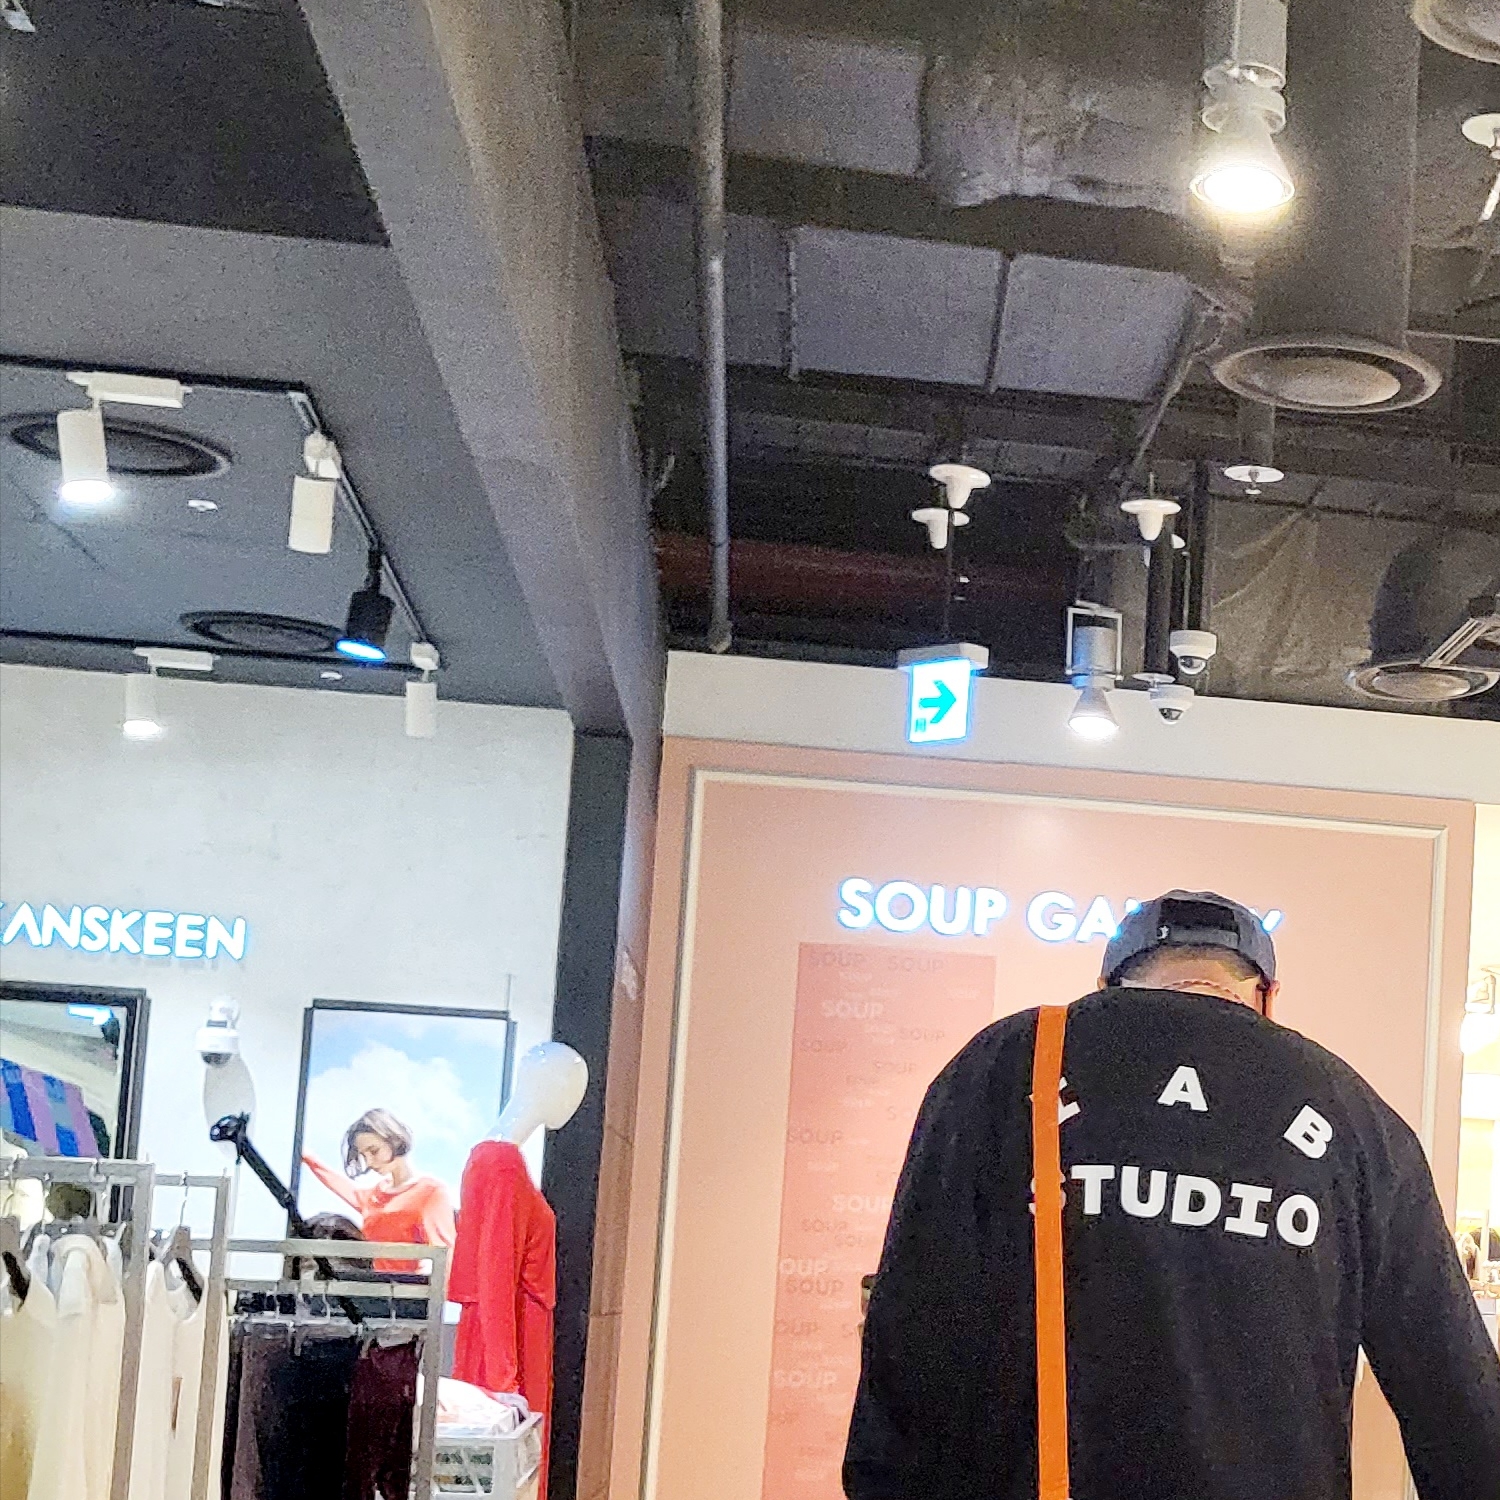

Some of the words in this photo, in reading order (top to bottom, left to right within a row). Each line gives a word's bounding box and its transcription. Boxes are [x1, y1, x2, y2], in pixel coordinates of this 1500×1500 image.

[838, 877, 1007, 936] SOUP
[0, 901, 247, 961] ANSKEEN
[887, 955, 944, 972] SOUP
[821, 999, 884, 1018] SOUP
[785, 1276, 844, 1297] SOUP
